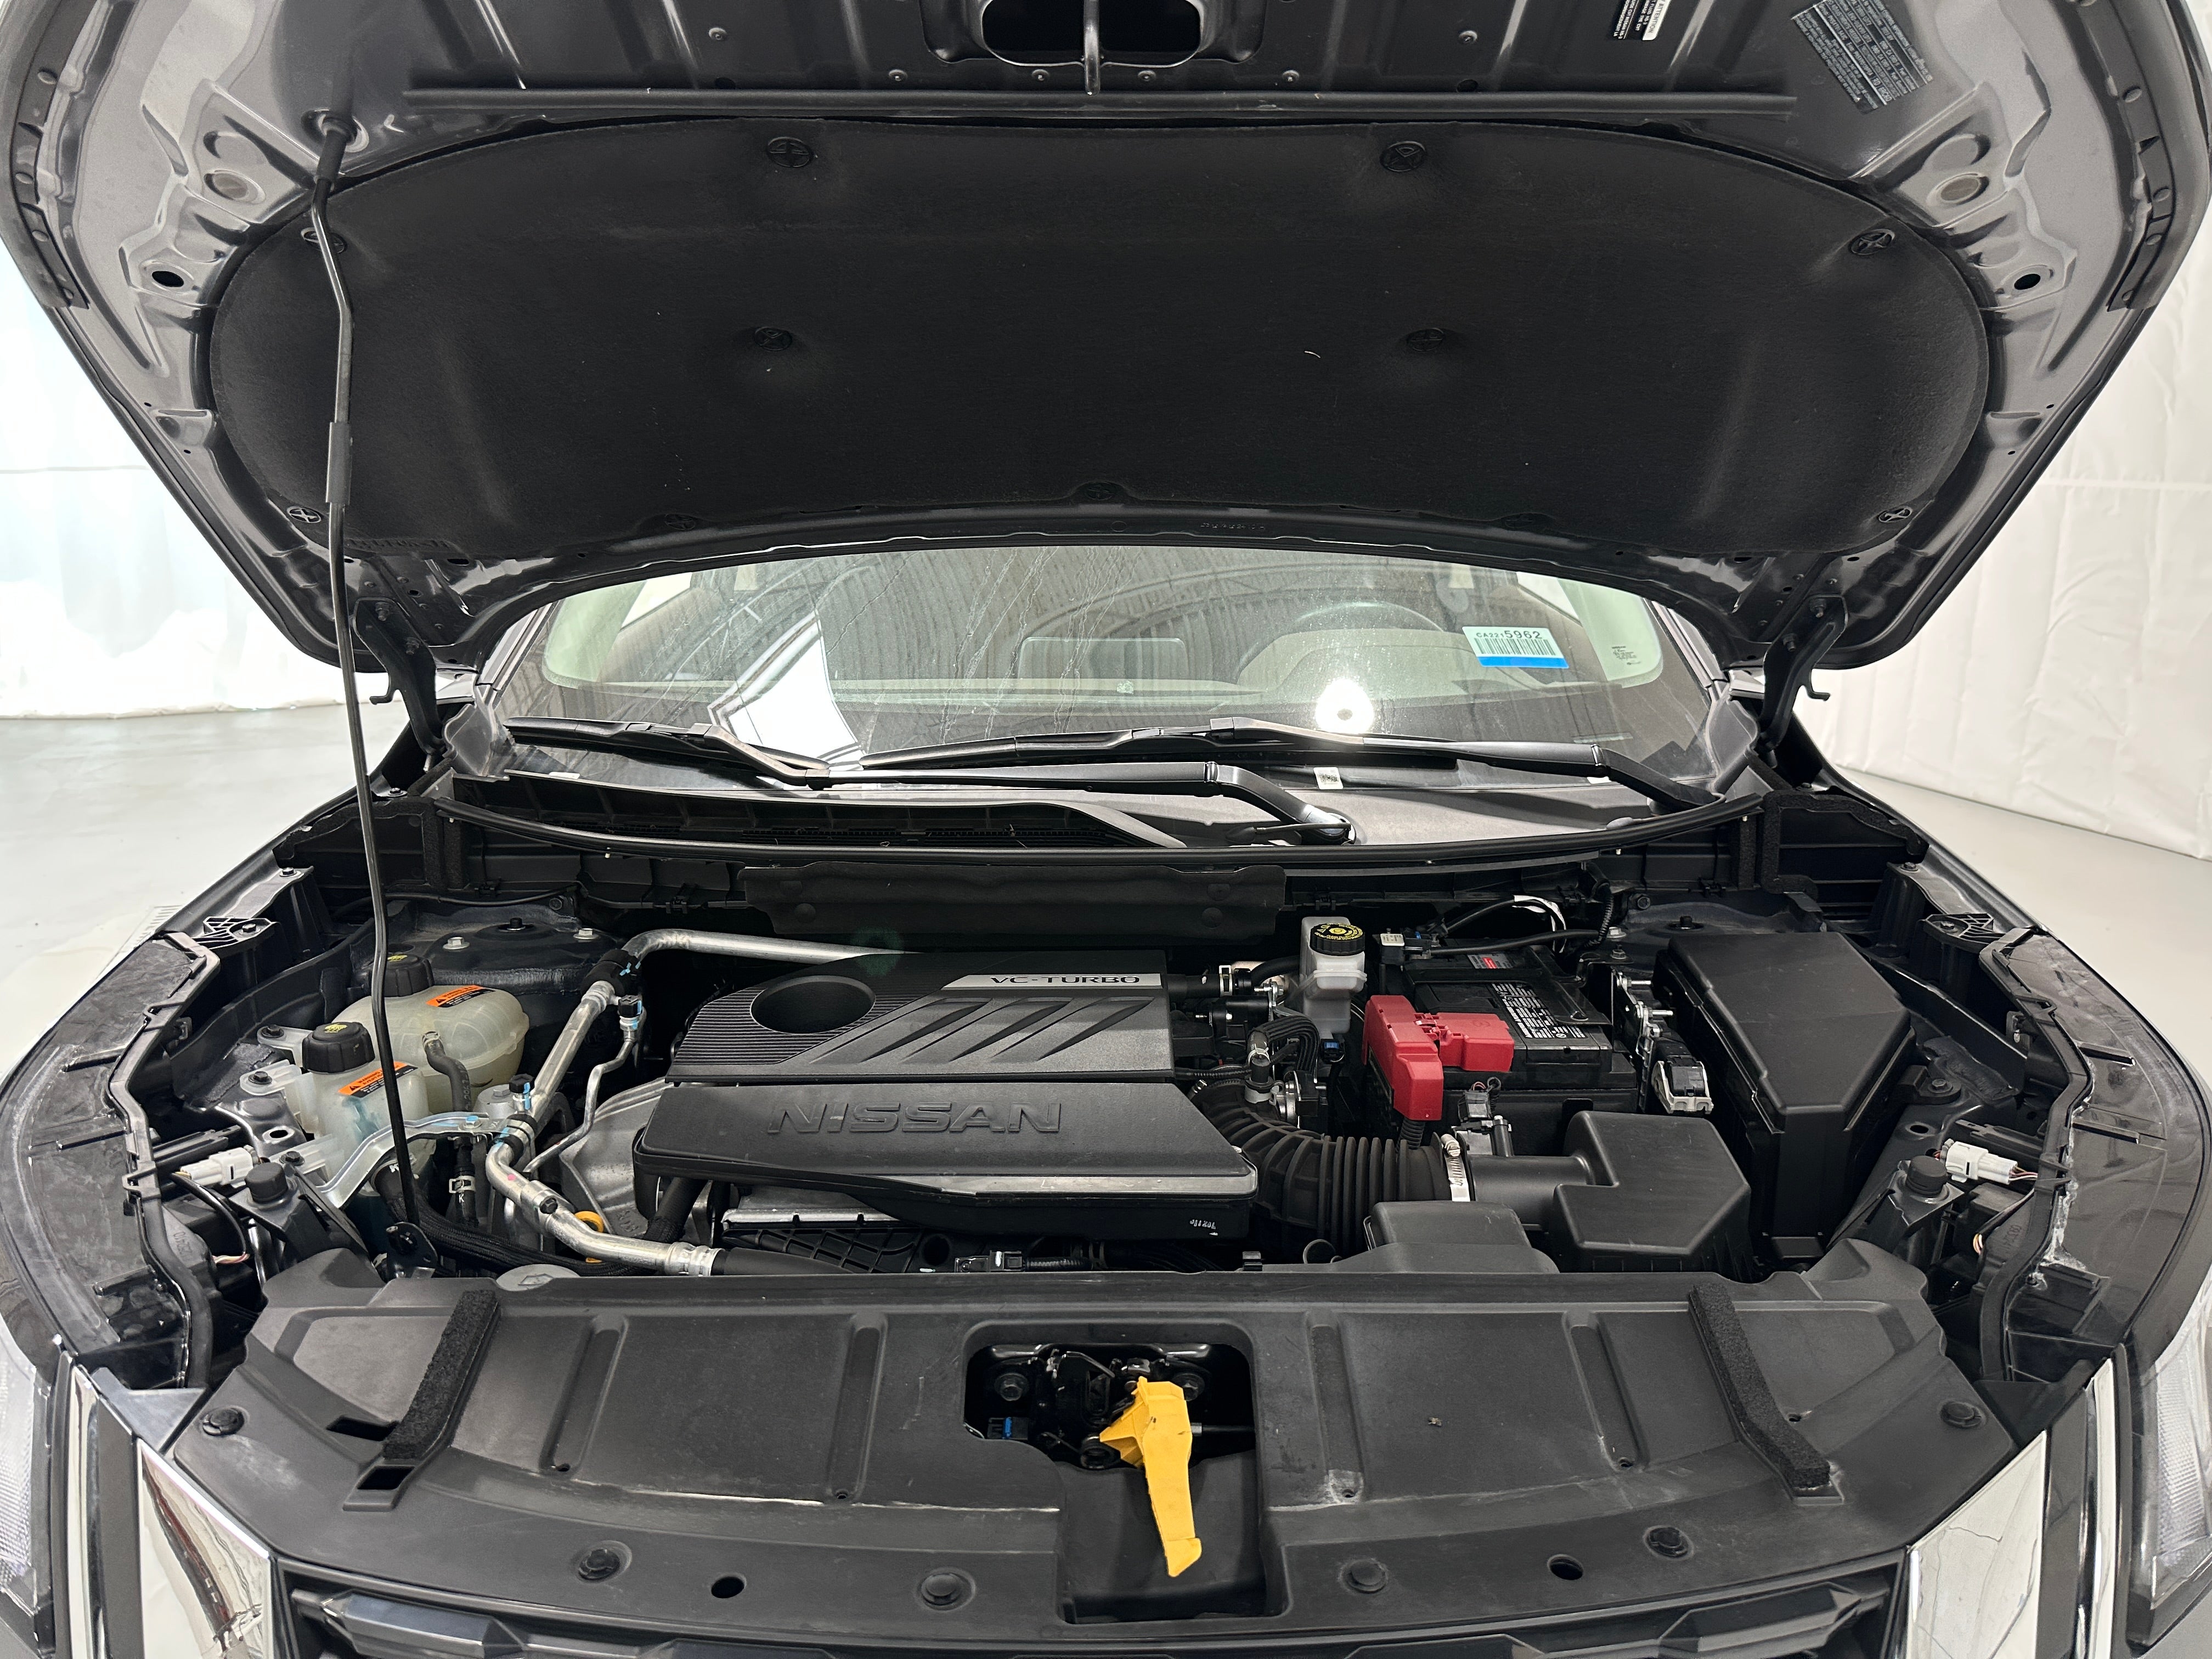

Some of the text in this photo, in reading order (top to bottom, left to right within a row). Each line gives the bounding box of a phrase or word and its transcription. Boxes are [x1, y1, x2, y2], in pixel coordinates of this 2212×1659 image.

[1649, 3, 1663, 33] ATTENTION
[1476, 630, 1542, 639] CA2215962
[767, 1103, 1061, 1133] NISSAN
[458, 1194, 465, 1203] K
